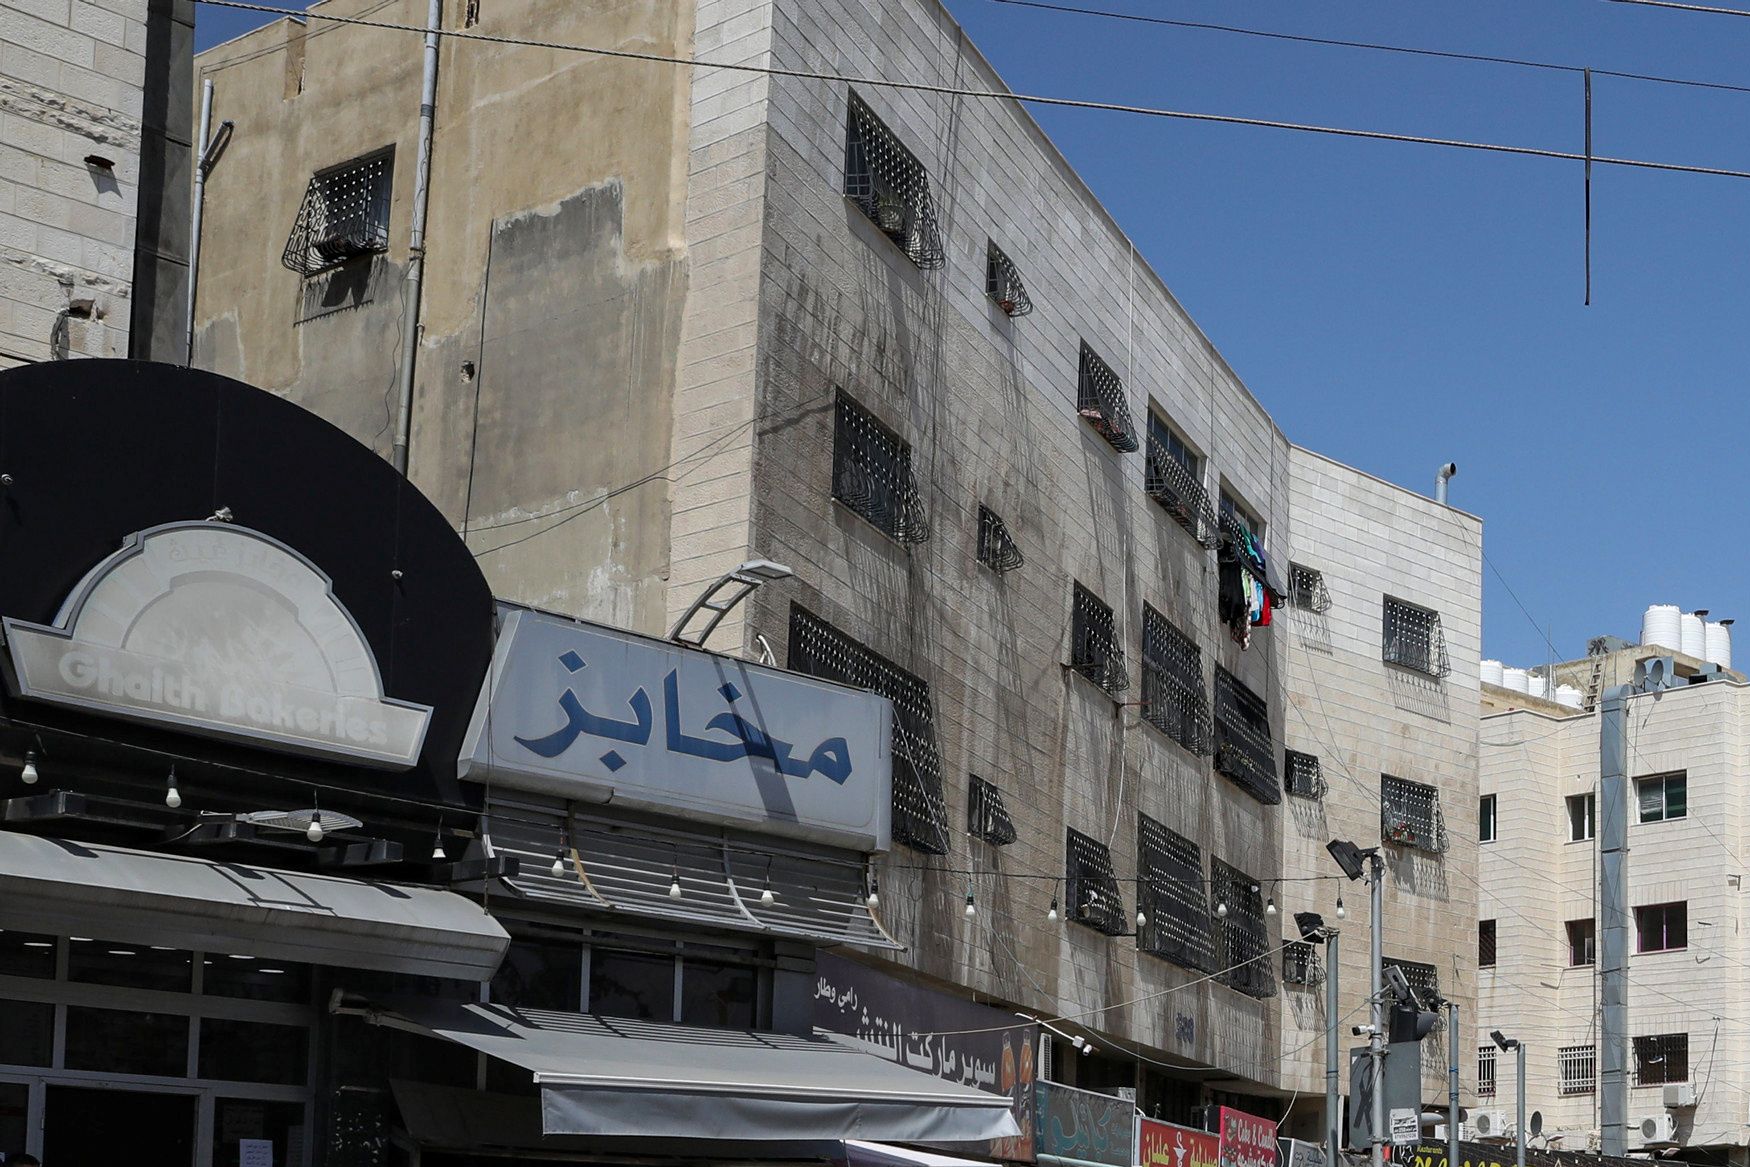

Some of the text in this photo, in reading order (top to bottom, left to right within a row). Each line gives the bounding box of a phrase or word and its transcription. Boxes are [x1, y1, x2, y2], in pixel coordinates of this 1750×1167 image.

[58, 650, 388, 746] Ghaith Bakeries
[512, 648, 853, 786] مخابز
[906, 1031, 956, 1080] ماركت
[956, 1052, 996, 1089] سوبر
